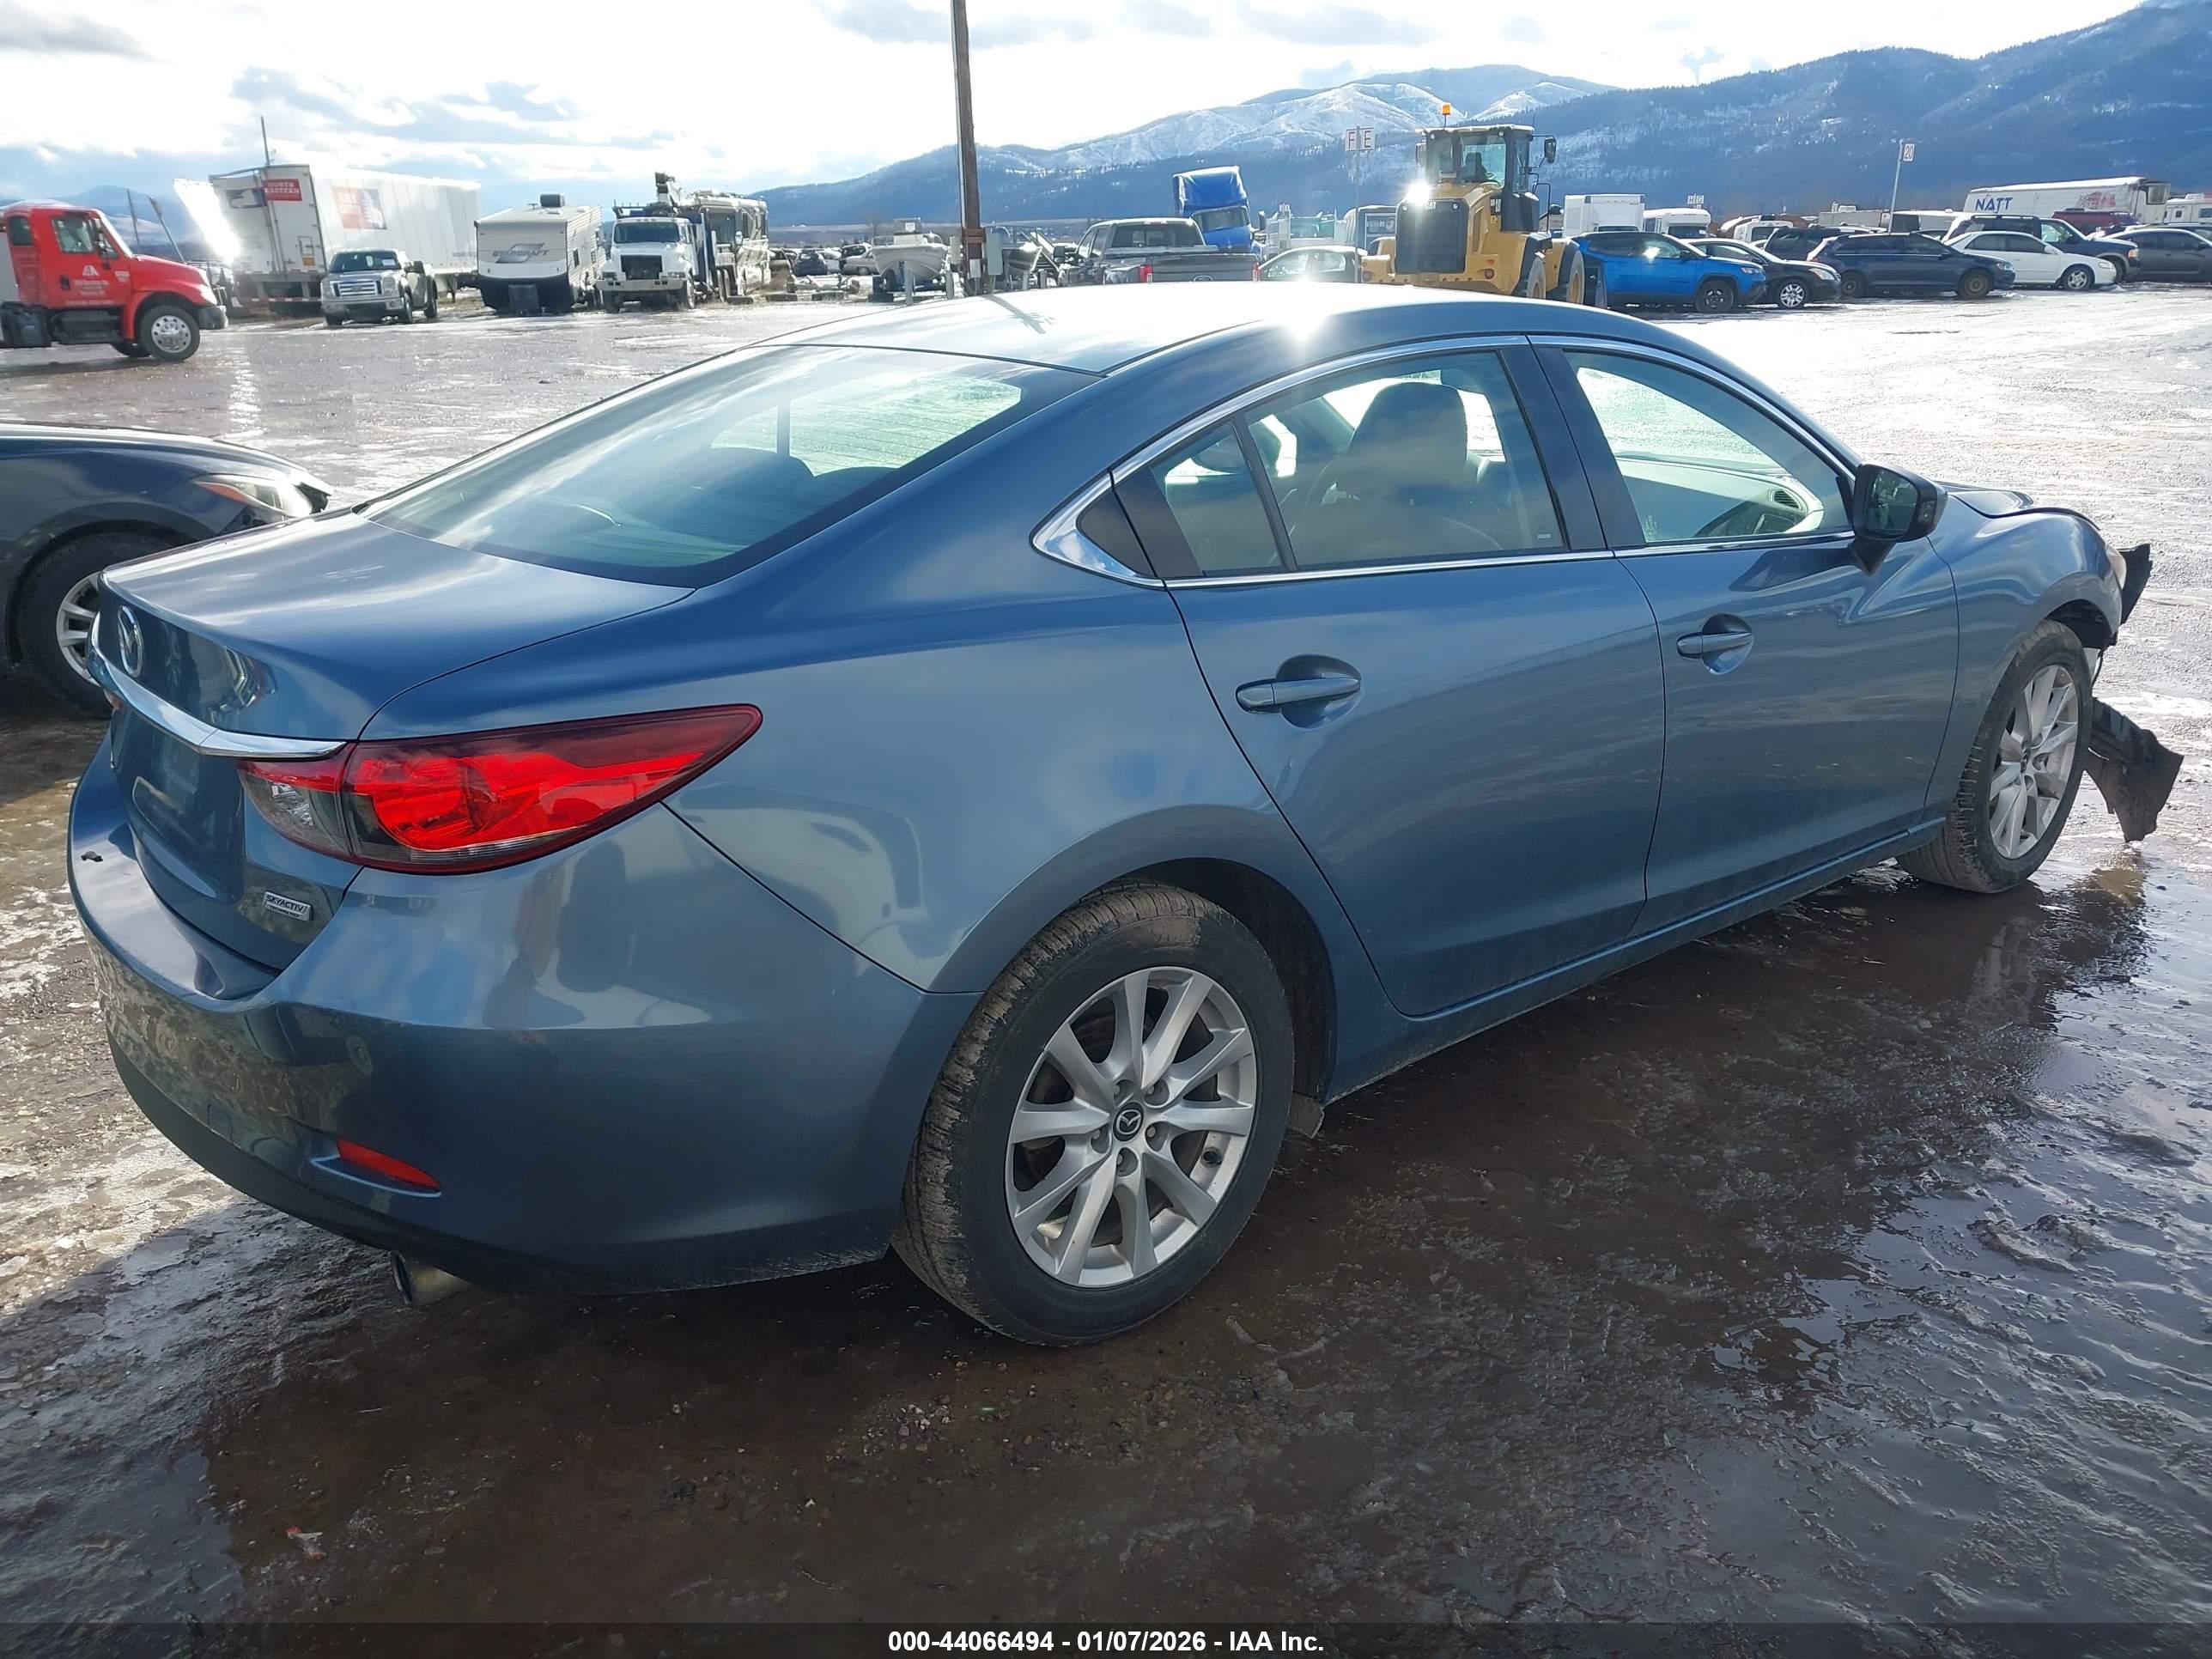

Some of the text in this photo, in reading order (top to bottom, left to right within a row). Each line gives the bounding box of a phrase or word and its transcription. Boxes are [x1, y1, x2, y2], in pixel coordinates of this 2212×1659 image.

[1348, 131, 1372, 149] F E
[1904, 144, 1914, 160] 20
[1974, 197, 2014, 214] NATT
[265, 894, 307, 912] SKYACTIV
